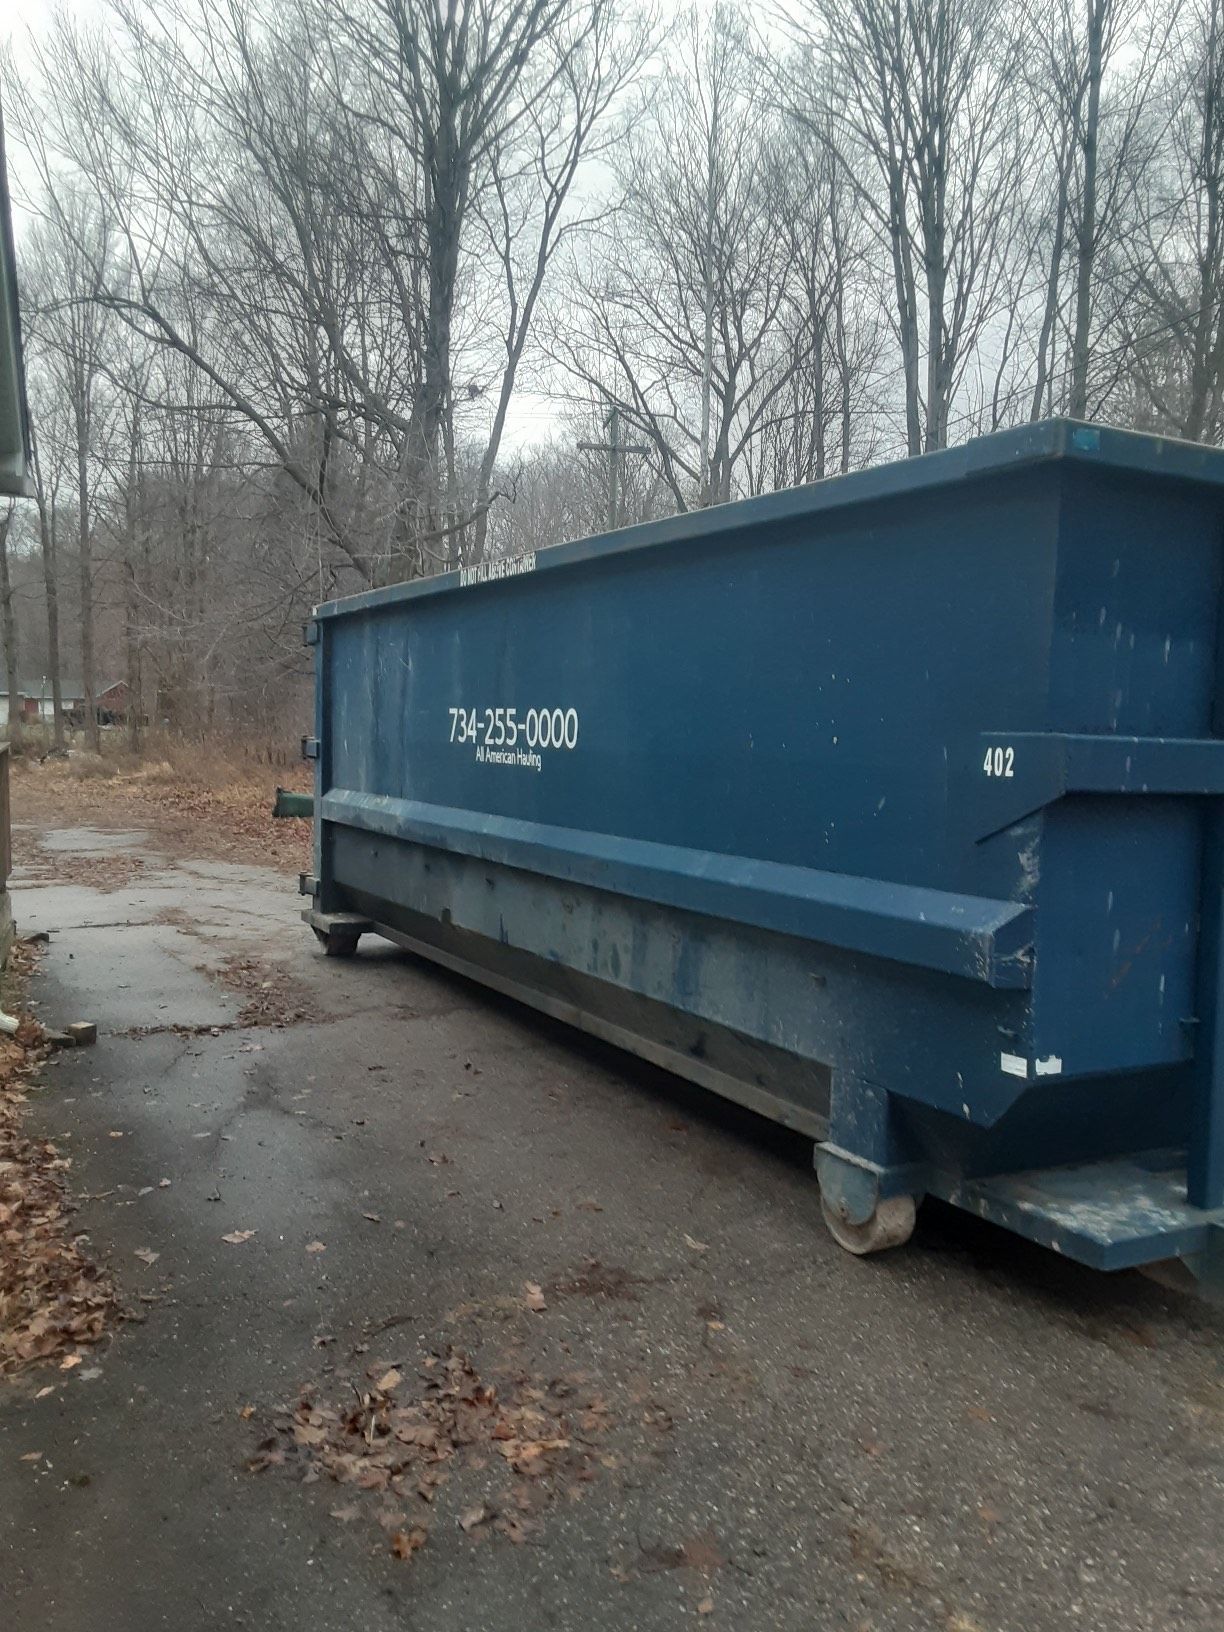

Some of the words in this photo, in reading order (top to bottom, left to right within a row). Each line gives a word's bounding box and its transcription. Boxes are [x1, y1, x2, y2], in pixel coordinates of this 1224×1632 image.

[449, 708, 579, 749] 734-255-0000
[475, 744, 485, 762] All
[485, 746, 516, 765] American
[516, 748, 542, 771] Hauling
[983, 747, 1015, 777] 402
